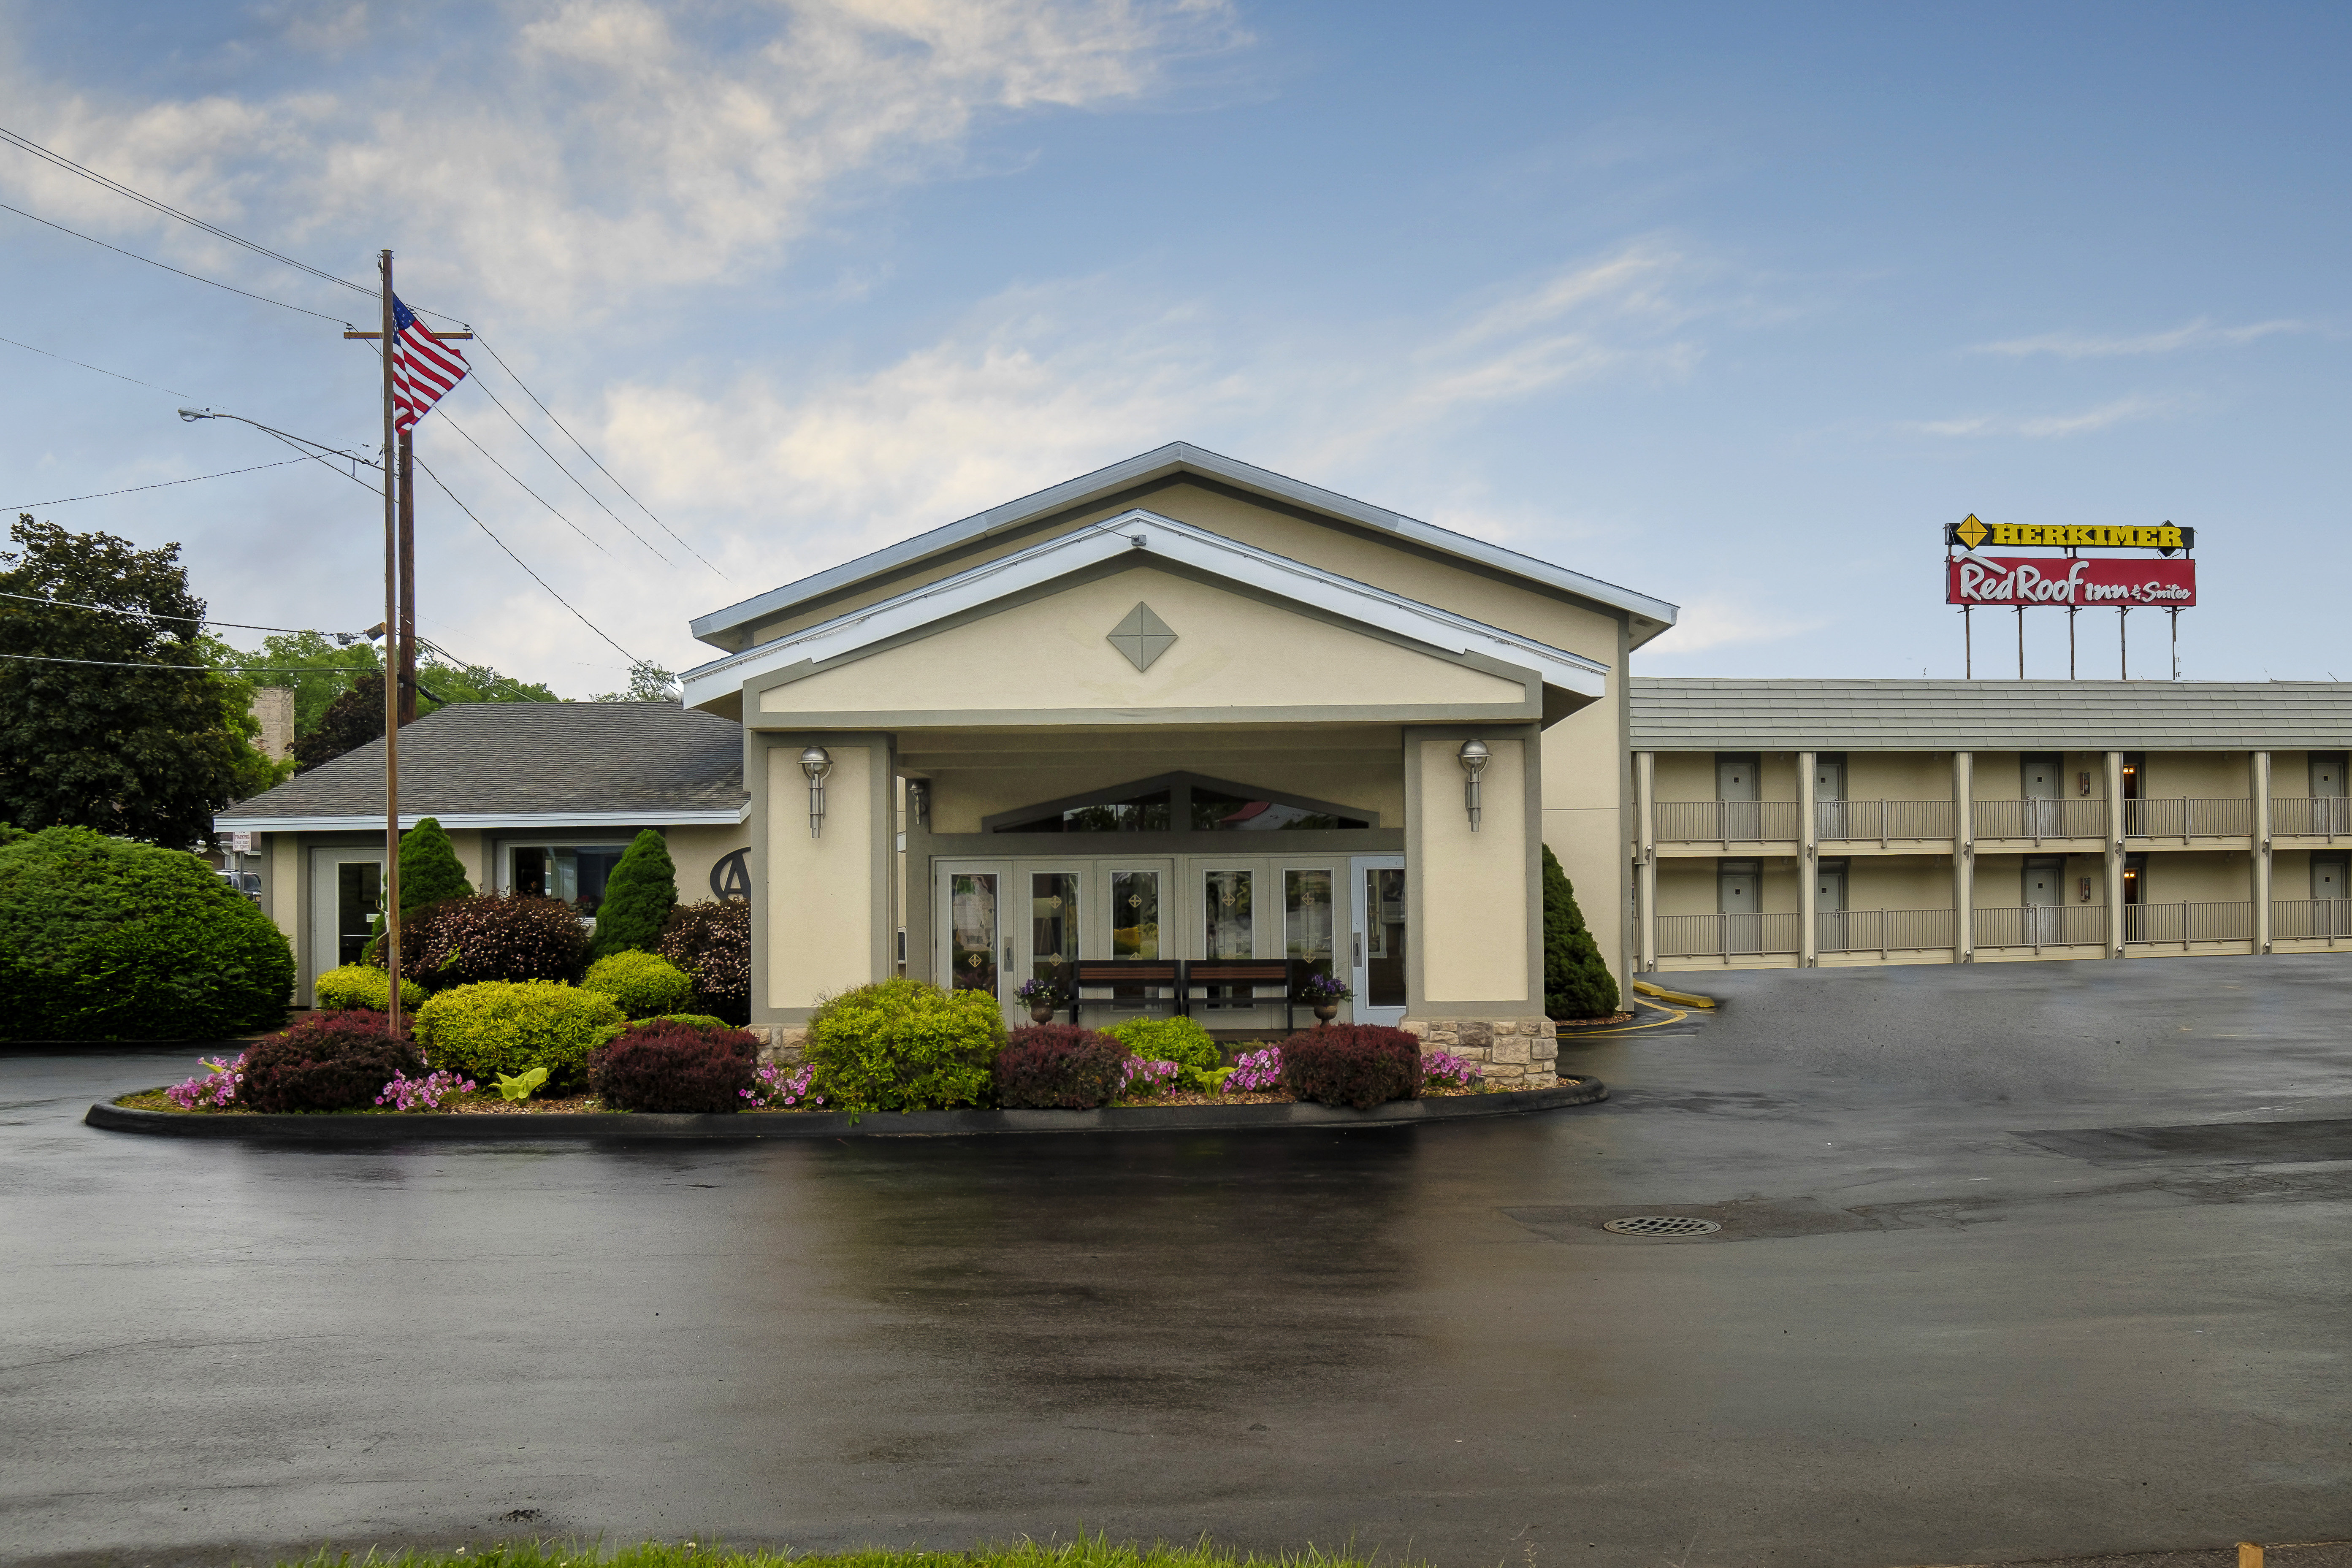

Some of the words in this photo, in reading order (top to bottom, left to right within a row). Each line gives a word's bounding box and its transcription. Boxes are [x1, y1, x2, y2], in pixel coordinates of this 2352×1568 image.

[1992, 523, 2183, 547] HERKIMER
[1960, 563, 2016, 601] Red
[2016, 561, 2089, 604] Roof
[2141, 581, 2192, 602] Suites
